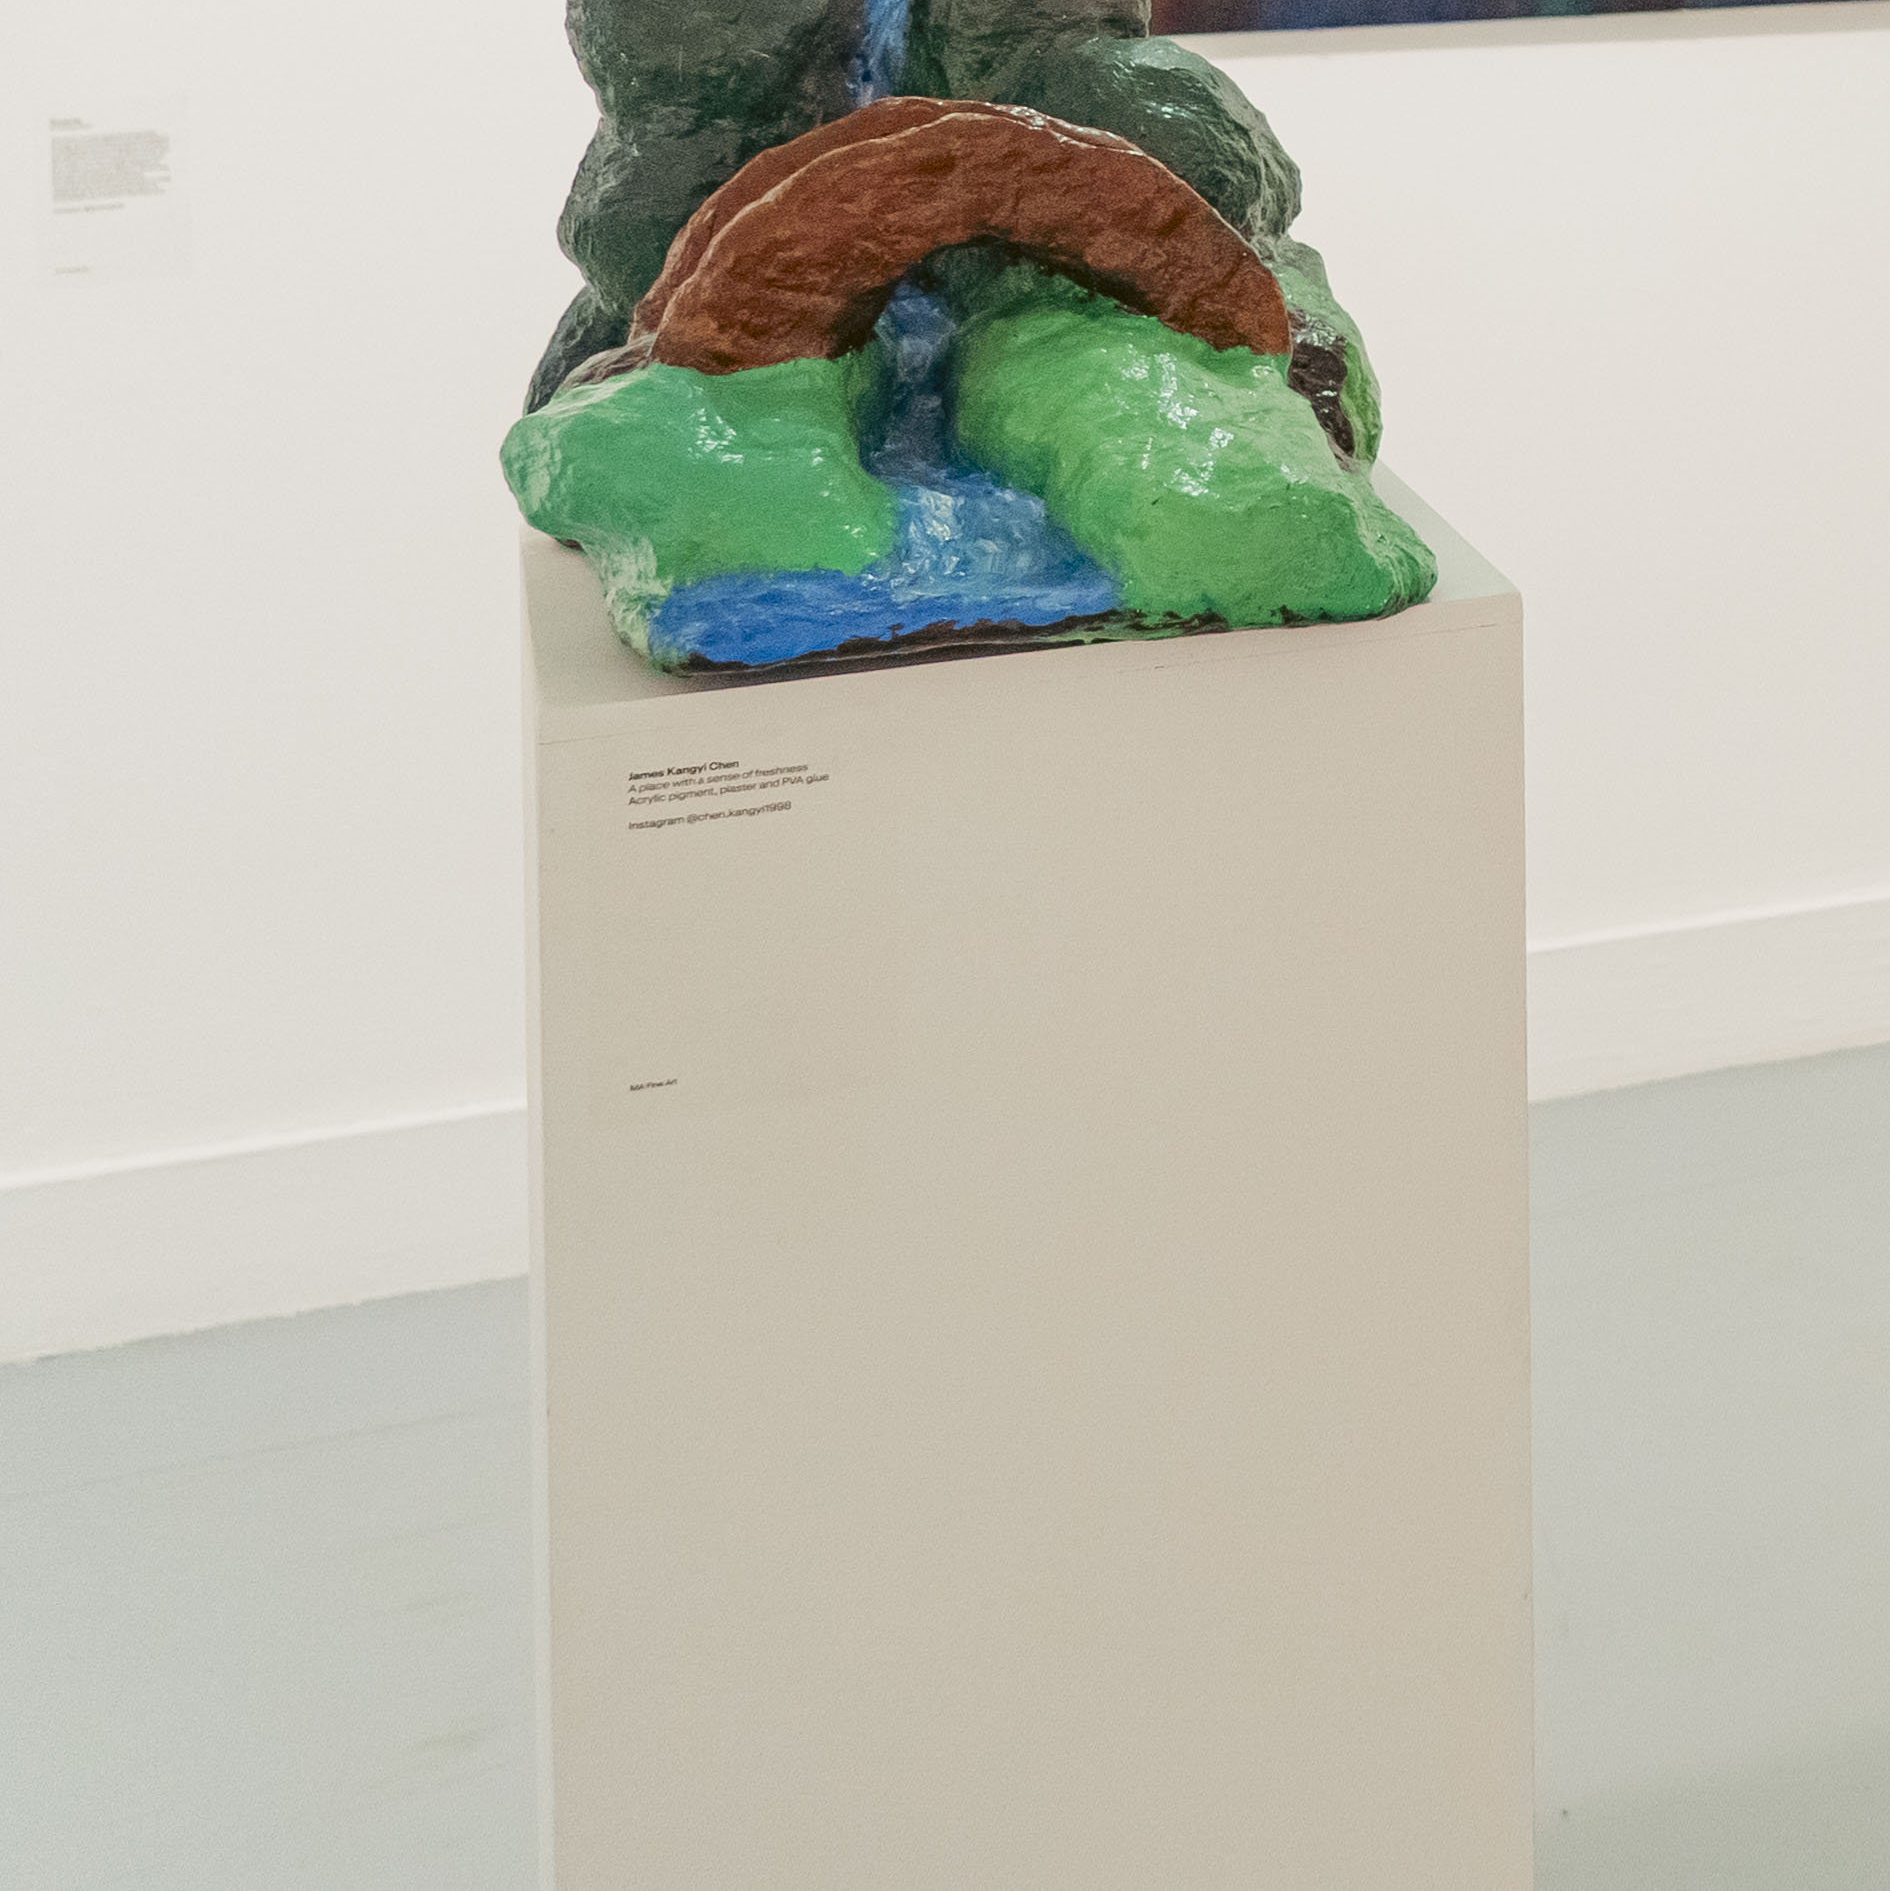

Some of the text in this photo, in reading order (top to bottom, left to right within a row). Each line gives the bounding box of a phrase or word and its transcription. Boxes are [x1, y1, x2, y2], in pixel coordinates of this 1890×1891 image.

[628, 761, 739, 781] James Kangyi Chen
[628, 764, 808, 793] A place with a sense of freshness
[628, 793, 667, 805] Acrylic
[720, 783, 757, 794] plaster
[759, 779, 780, 789] and
[782, 775, 804, 785] PVA
[806, 773, 830, 785] glue
[628, 816, 685, 830] Instagram
